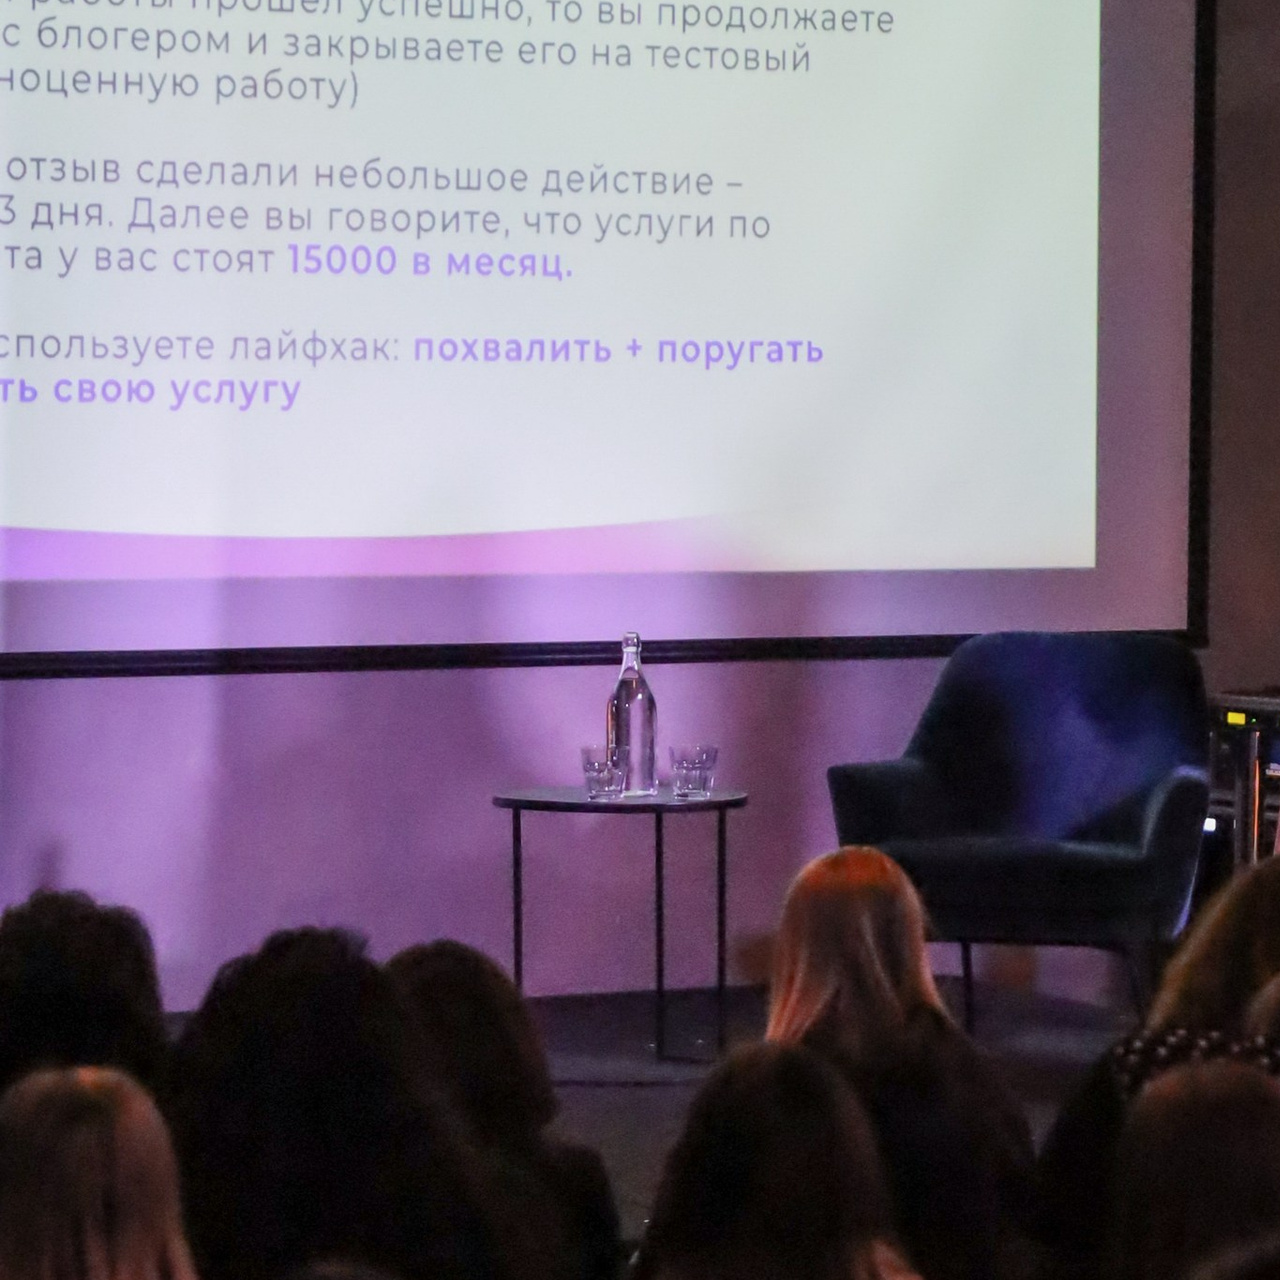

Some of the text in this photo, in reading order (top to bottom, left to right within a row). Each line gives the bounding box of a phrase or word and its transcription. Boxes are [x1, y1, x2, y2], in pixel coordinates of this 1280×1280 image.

[546, 0, 582, 24] то
[598, 1, 641, 25] вы
[658, 3, 894, 34] продолжаете
[2, 16, 809, 72] с блогером и закрываете его на тестовый
[216, 68, 358, 109] работу)
[6, 157, 120, 183] отзыв
[137, 160, 297, 189] сделали
[315, 157, 528, 192] небольшое
[541, 164, 713, 197] действие
[31, 202, 113, 231] дня.
[128, 197, 249, 233] Далее
[266, 207, 311, 231] вы
[329, 208, 509, 240] говорите,
[524, 212, 581, 235] что
[595, 213, 713, 244] услуги
[730, 216, 770, 239] по
[4, 244, 572, 281] та у вас стоят 15000 в месяц.
[230, 329, 398, 368] лайфхак:
[415, 338, 611, 363] похвалить
[658, 340, 823, 371] поругать
[0, 378, 300, 412] ть свою услугу
